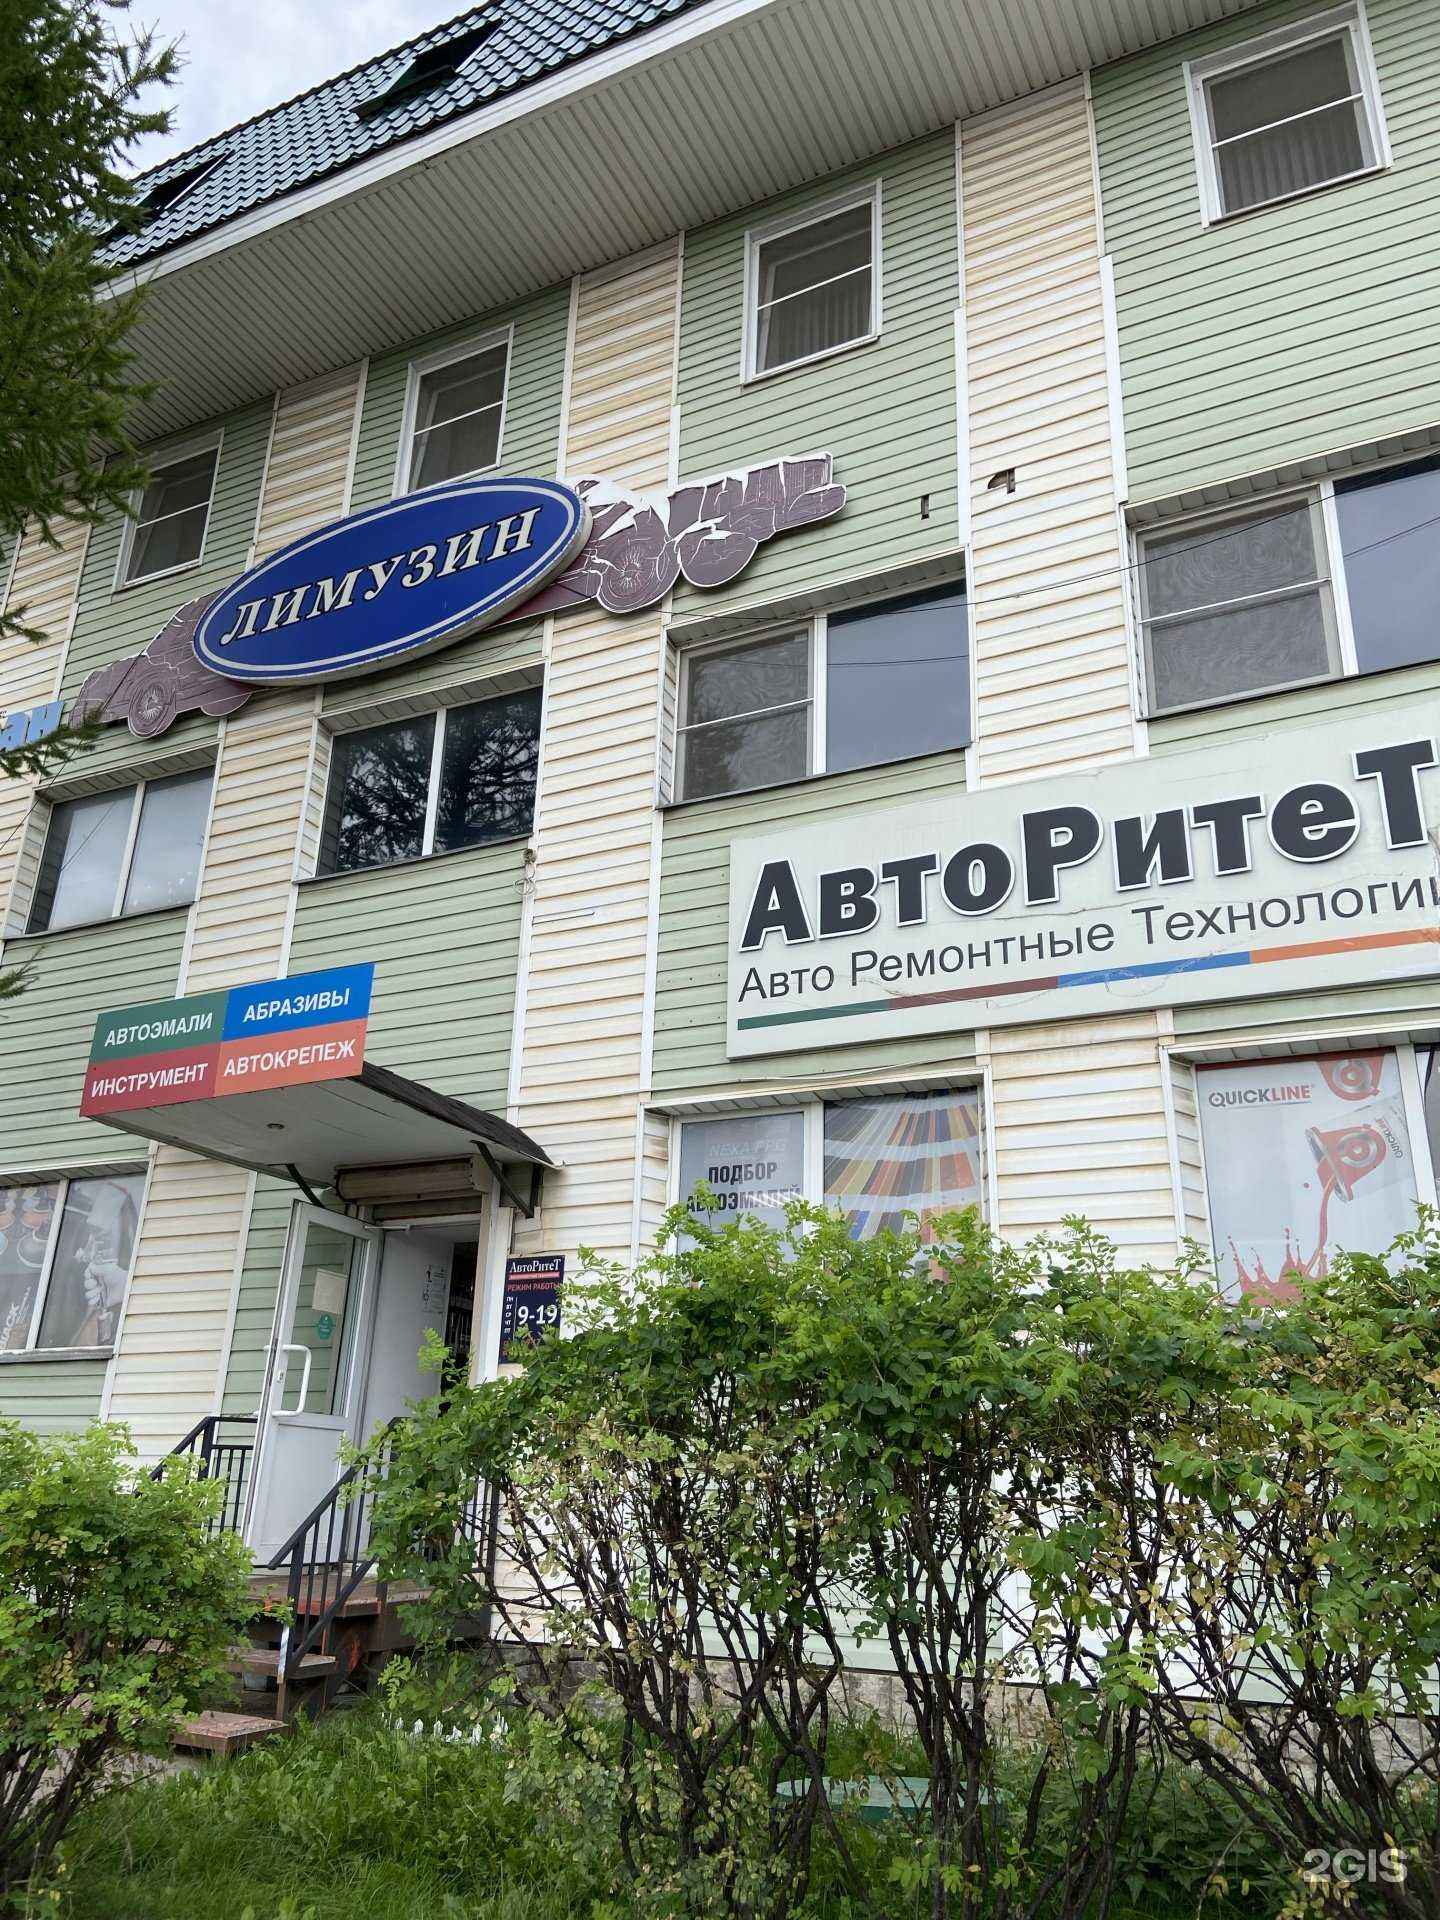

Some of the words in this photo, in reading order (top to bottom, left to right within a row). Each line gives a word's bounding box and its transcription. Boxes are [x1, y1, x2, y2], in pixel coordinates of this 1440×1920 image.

[220, 507, 544, 646] ЛИМУЗИН
[738, 736, 1439, 952] АвтоРитеТ
[738, 965, 836, 1002] Авто
[851, 922, 1115, 987] Ремонтные
[243, 988, 351, 1023] АБРАЗИВЫ
[104, 1012, 214, 1048] АВТОЭМАЛИ
[224, 1038, 357, 1078] АВТОКРЕПЕЖ
[91, 1062, 209, 1099] ИНСТРУМЕНТ
[1208, 1084, 1312, 1108] QUICKLINE
[708, 1161, 778, 1185] ПОДБОР
[510, 1258, 562, 1273] АвтоРитеТ
[507, 1283, 532, 1292] РЕЖИМ
[517, 1304, 558, 1325] 9-19
